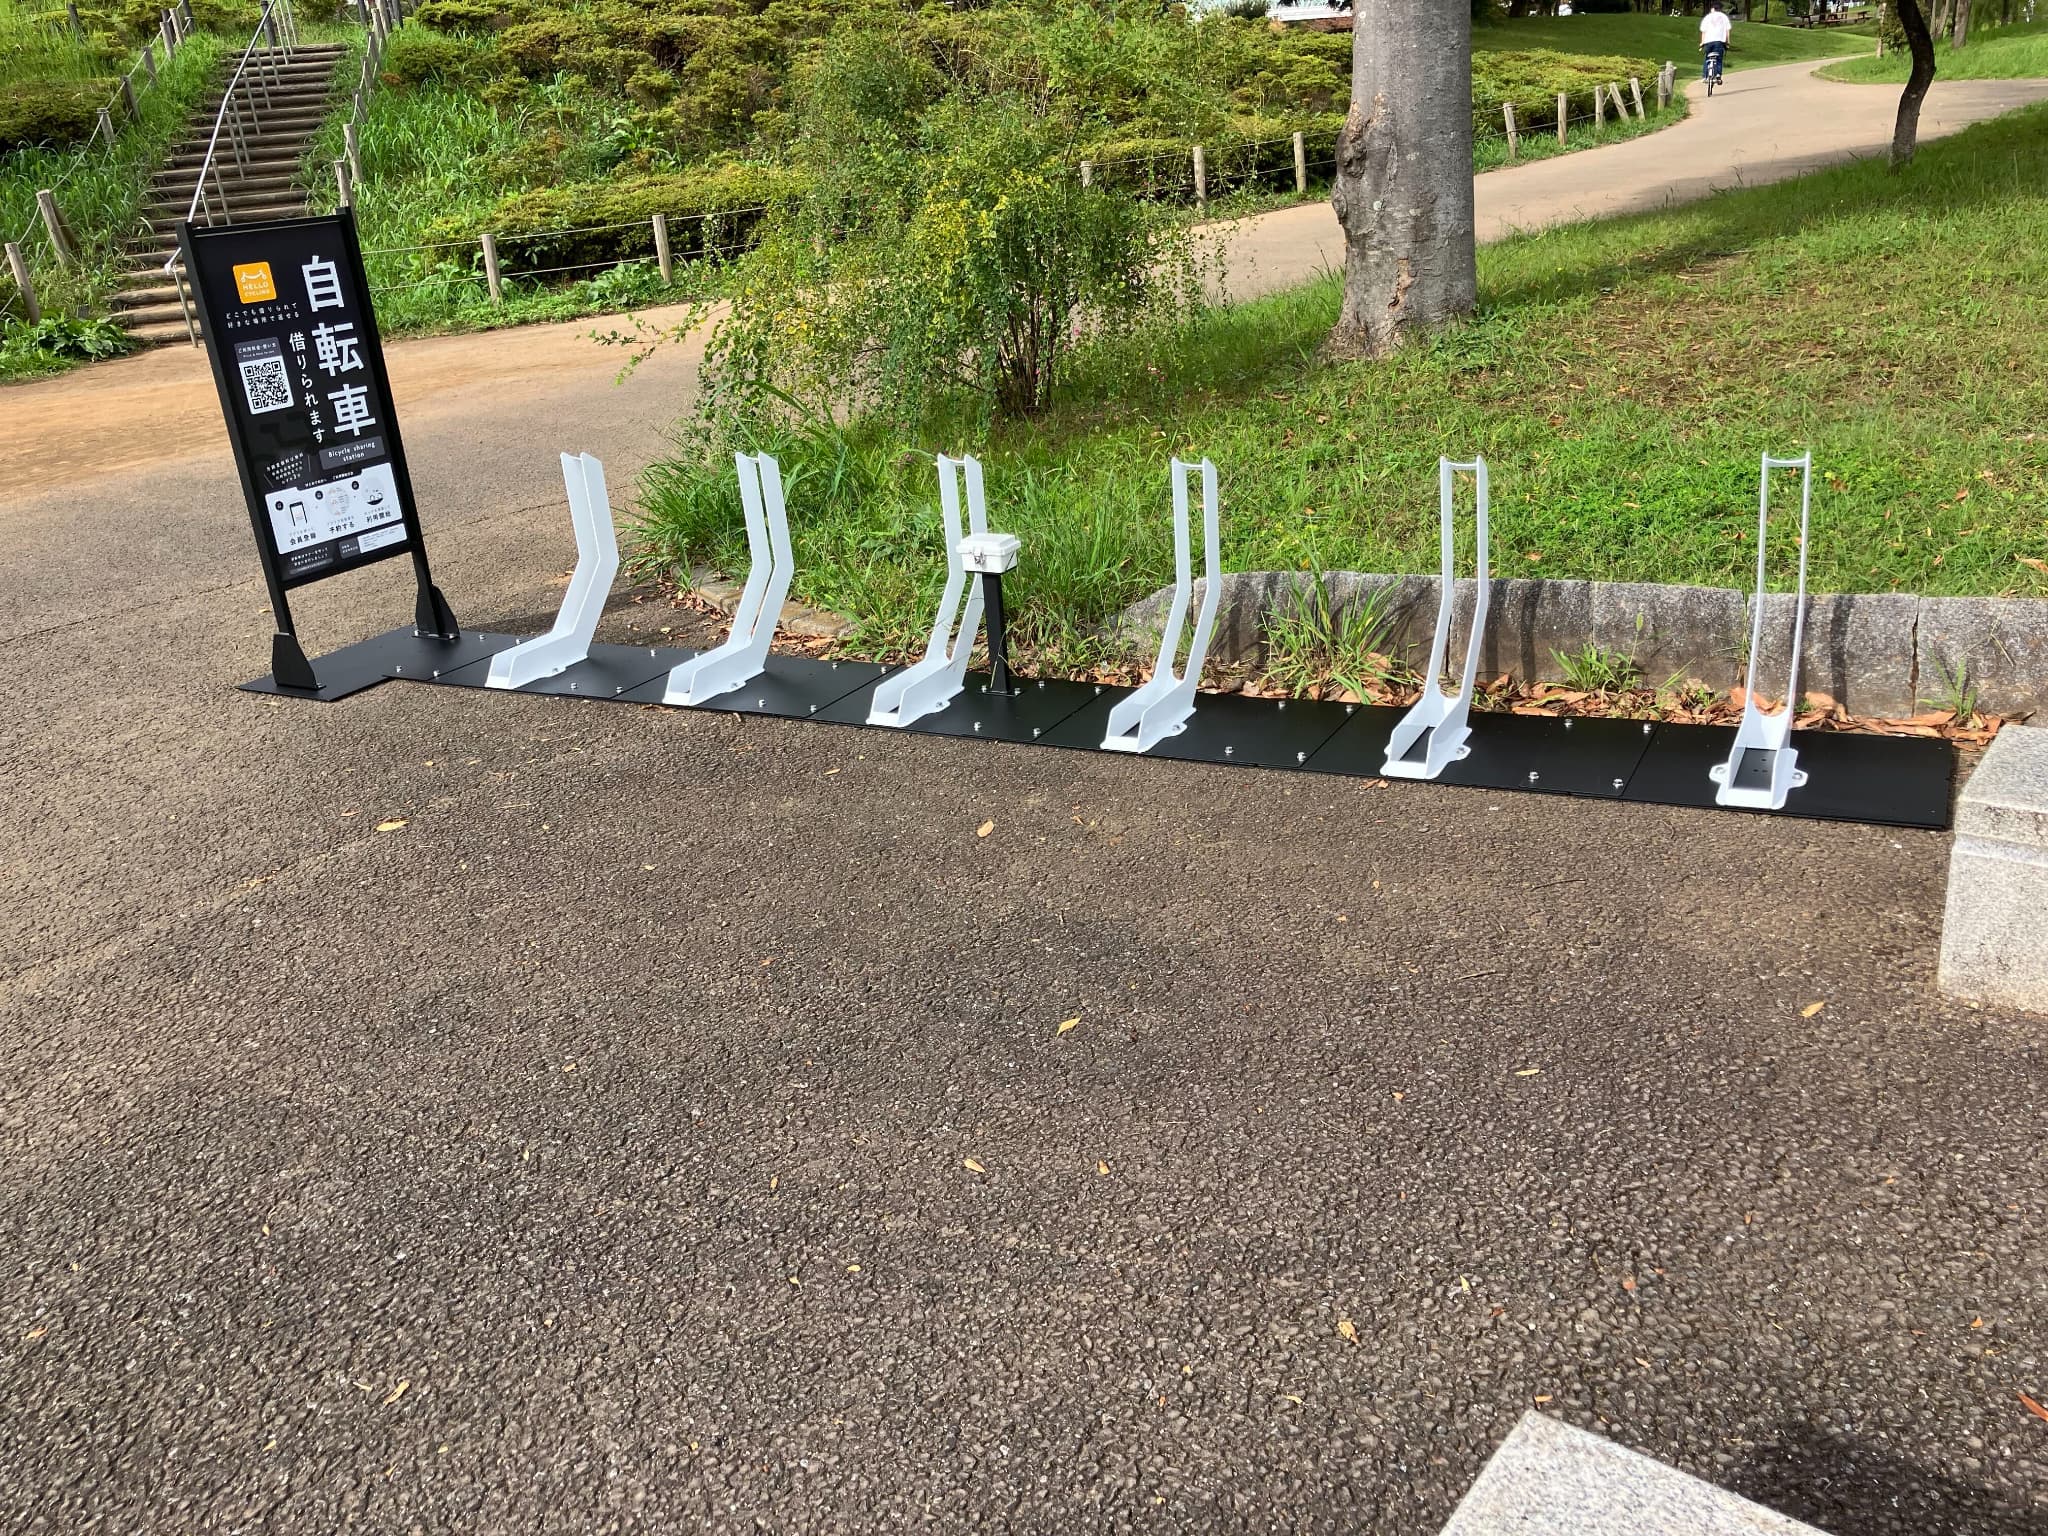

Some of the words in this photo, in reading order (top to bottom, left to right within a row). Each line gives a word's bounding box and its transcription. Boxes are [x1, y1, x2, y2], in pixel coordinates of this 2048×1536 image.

[242, 282, 269, 291] HELLO
[301, 255, 376, 437] 自転車
[289, 331, 326, 444] 借りられます
[328, 447, 351, 459] Bicycle
[353, 442, 376, 452] sharing
[342, 452, 365, 461] station
